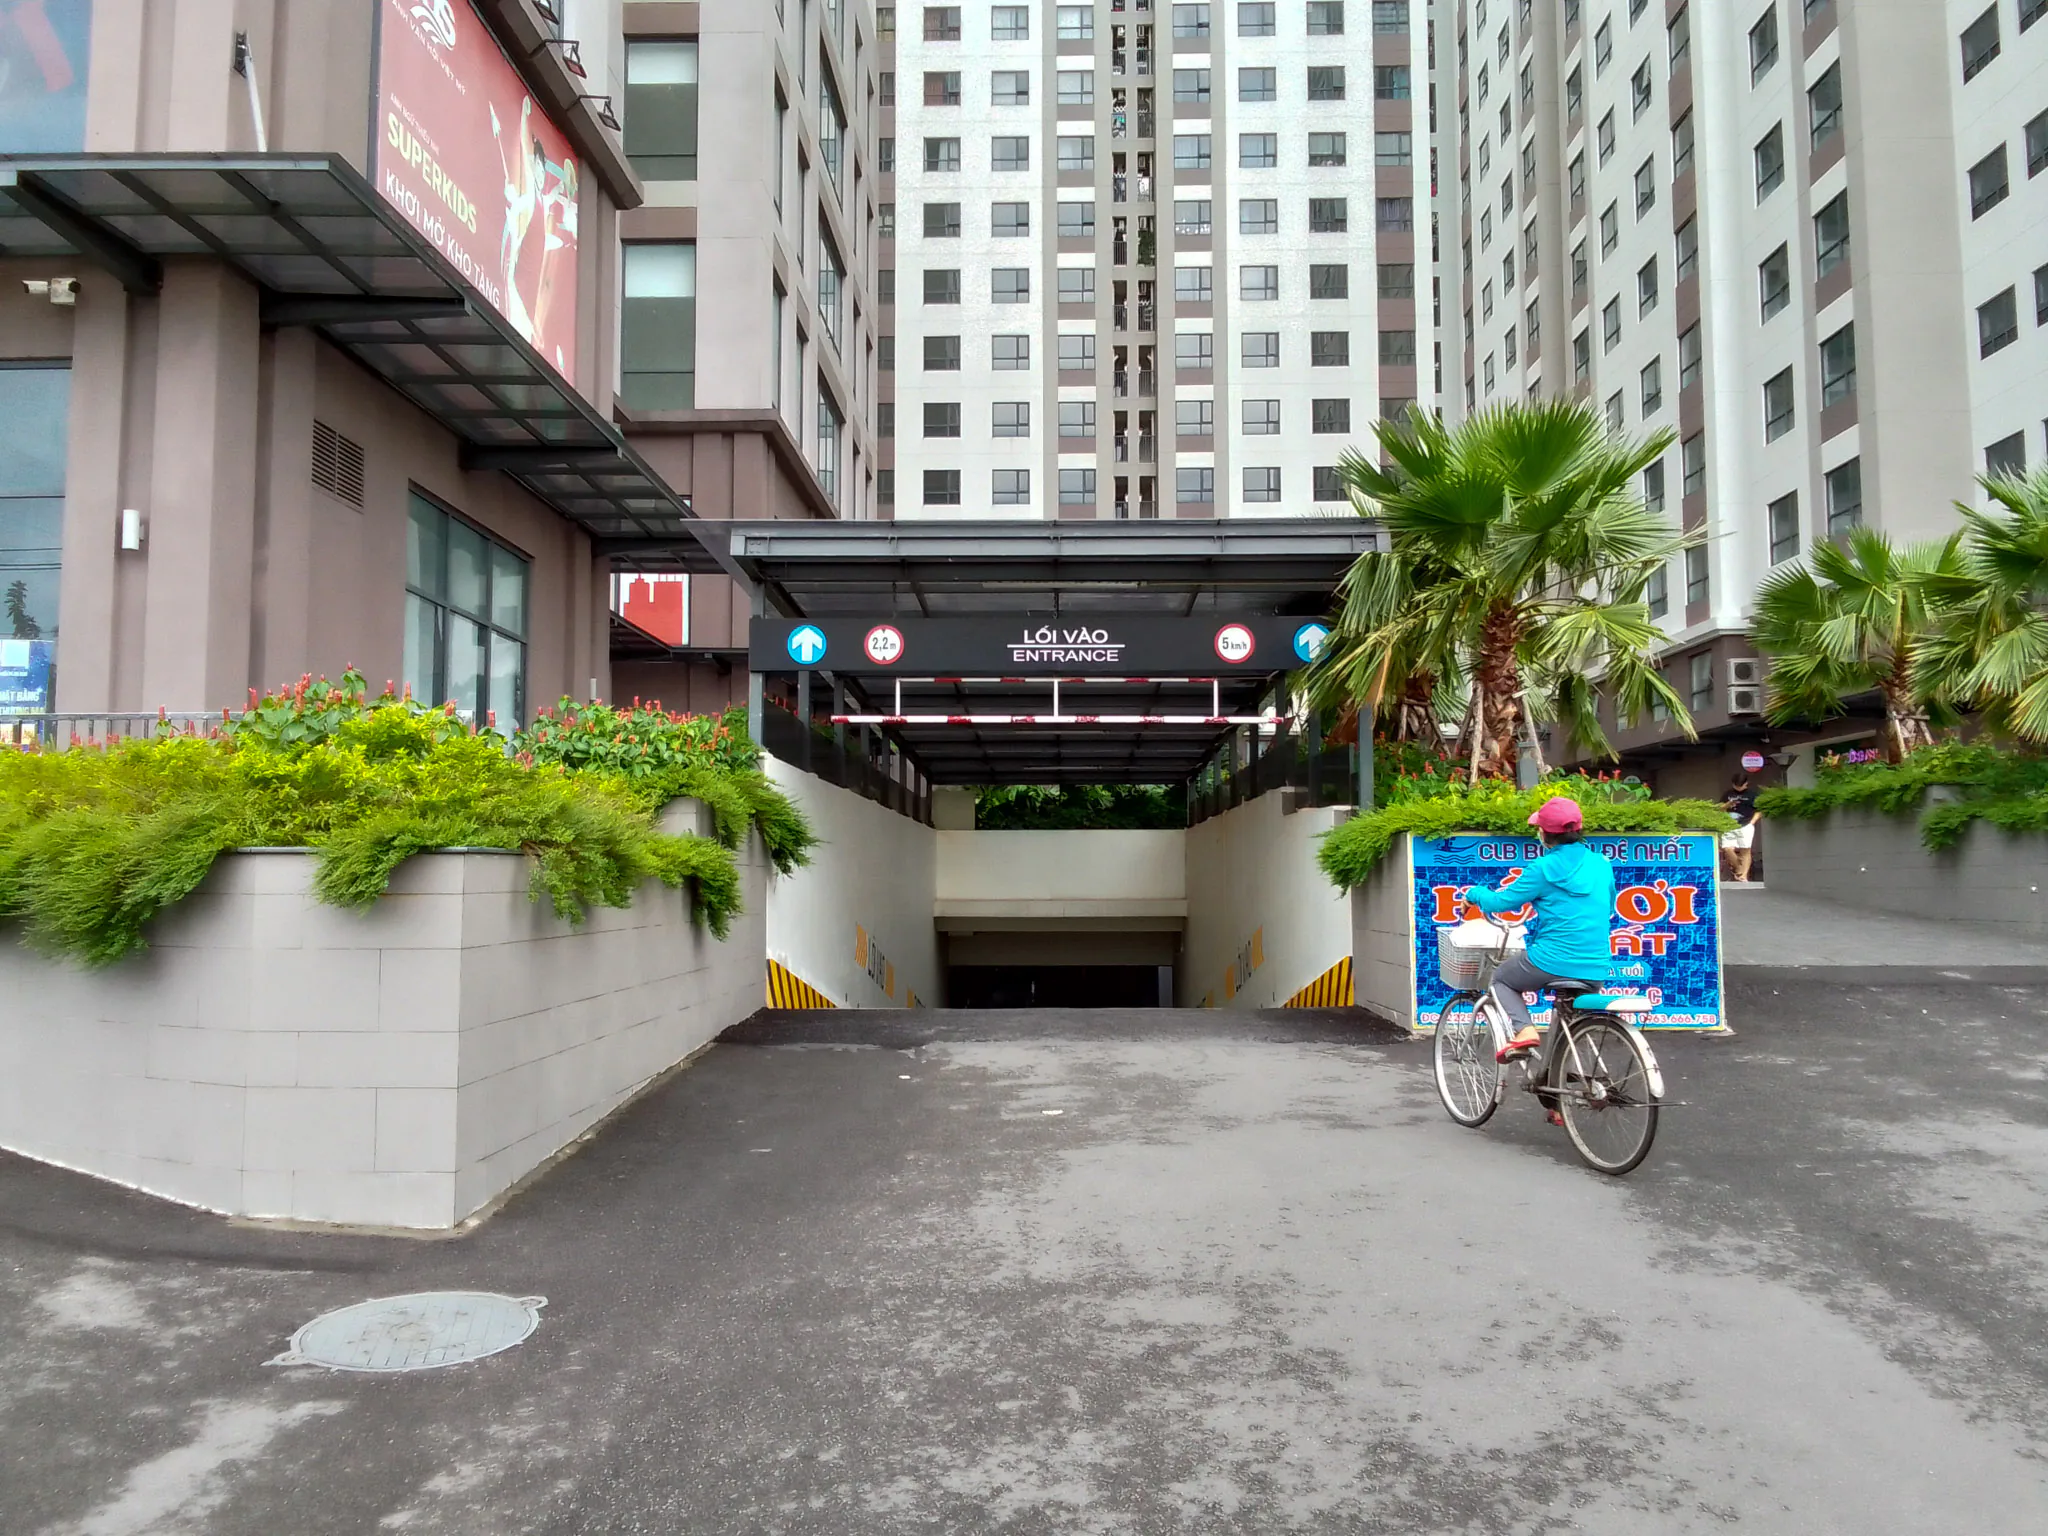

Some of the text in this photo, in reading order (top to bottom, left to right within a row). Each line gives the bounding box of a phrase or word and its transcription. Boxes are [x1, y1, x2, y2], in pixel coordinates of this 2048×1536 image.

[387, 111, 477, 235] SUPERKIDS
[386, 168, 500, 310] KHƠI MỞ KHO TÀNG
[1023, 625, 1109, 644] LỐI VÀO
[1013, 650, 1120, 663] ENTRANCE
[1479, 842, 1518, 861] CLB
[1634, 837, 1694, 862] NHẤT
[1612, 879, 1700, 924] ƠI
